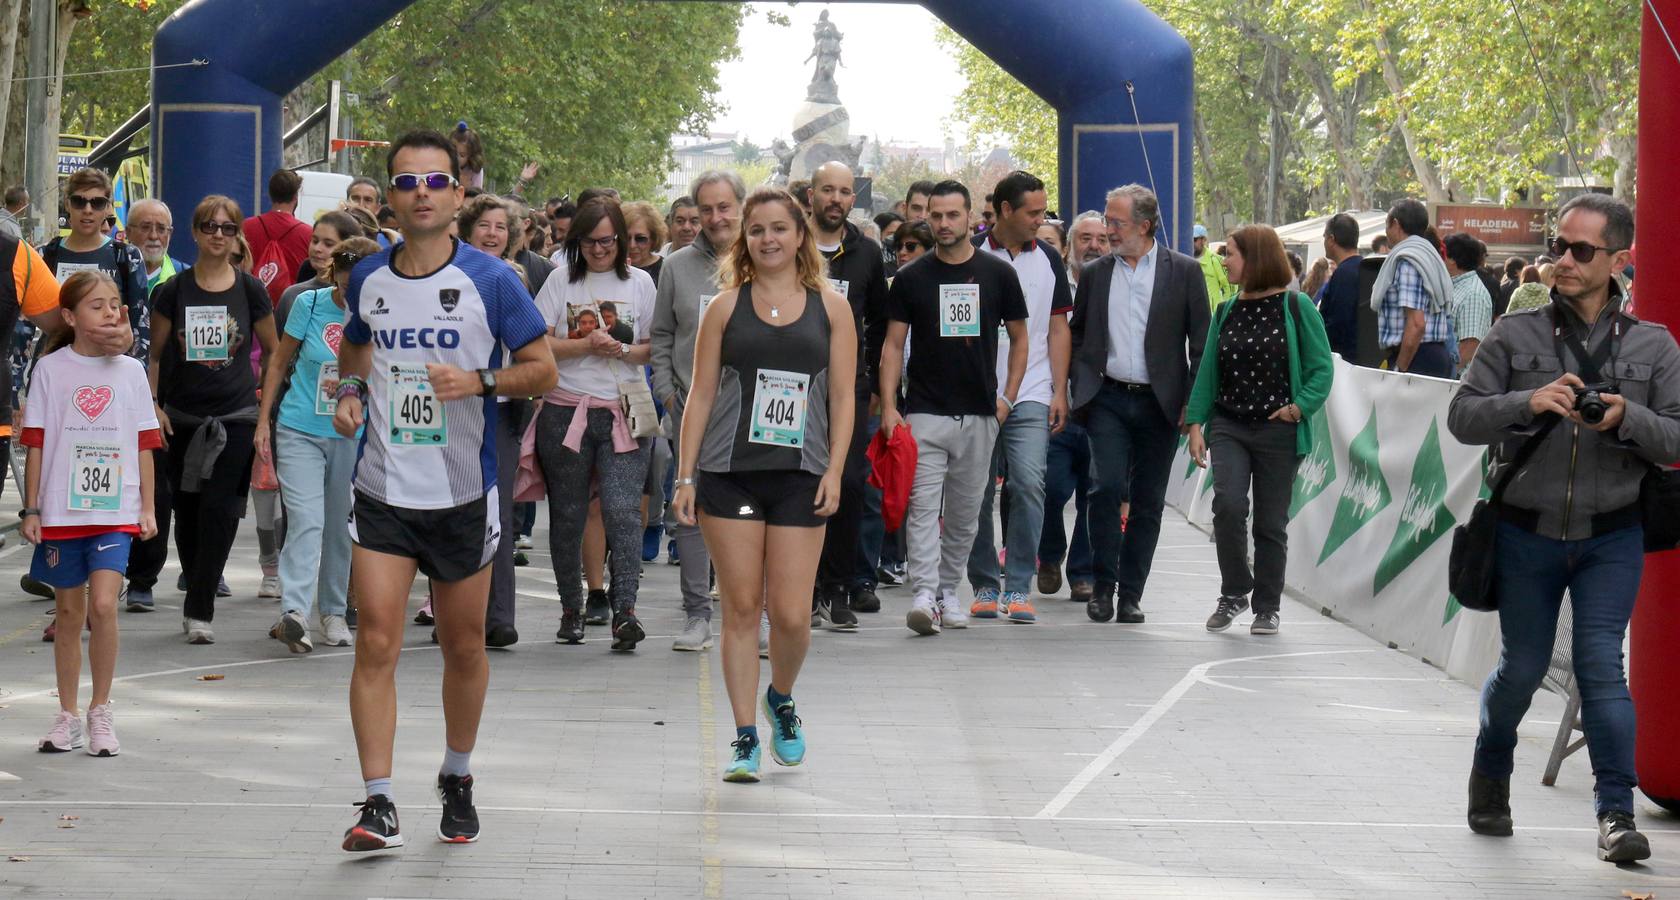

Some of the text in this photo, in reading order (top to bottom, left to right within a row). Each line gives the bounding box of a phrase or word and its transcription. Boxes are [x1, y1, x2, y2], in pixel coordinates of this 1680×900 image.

[949, 303, 972, 322] 368
[192, 325, 222, 346] 1125
[373, 327, 460, 350] IVECO
[400, 394, 433, 425] 405
[765, 398, 795, 427] 404
[81, 466, 111, 493] 384
